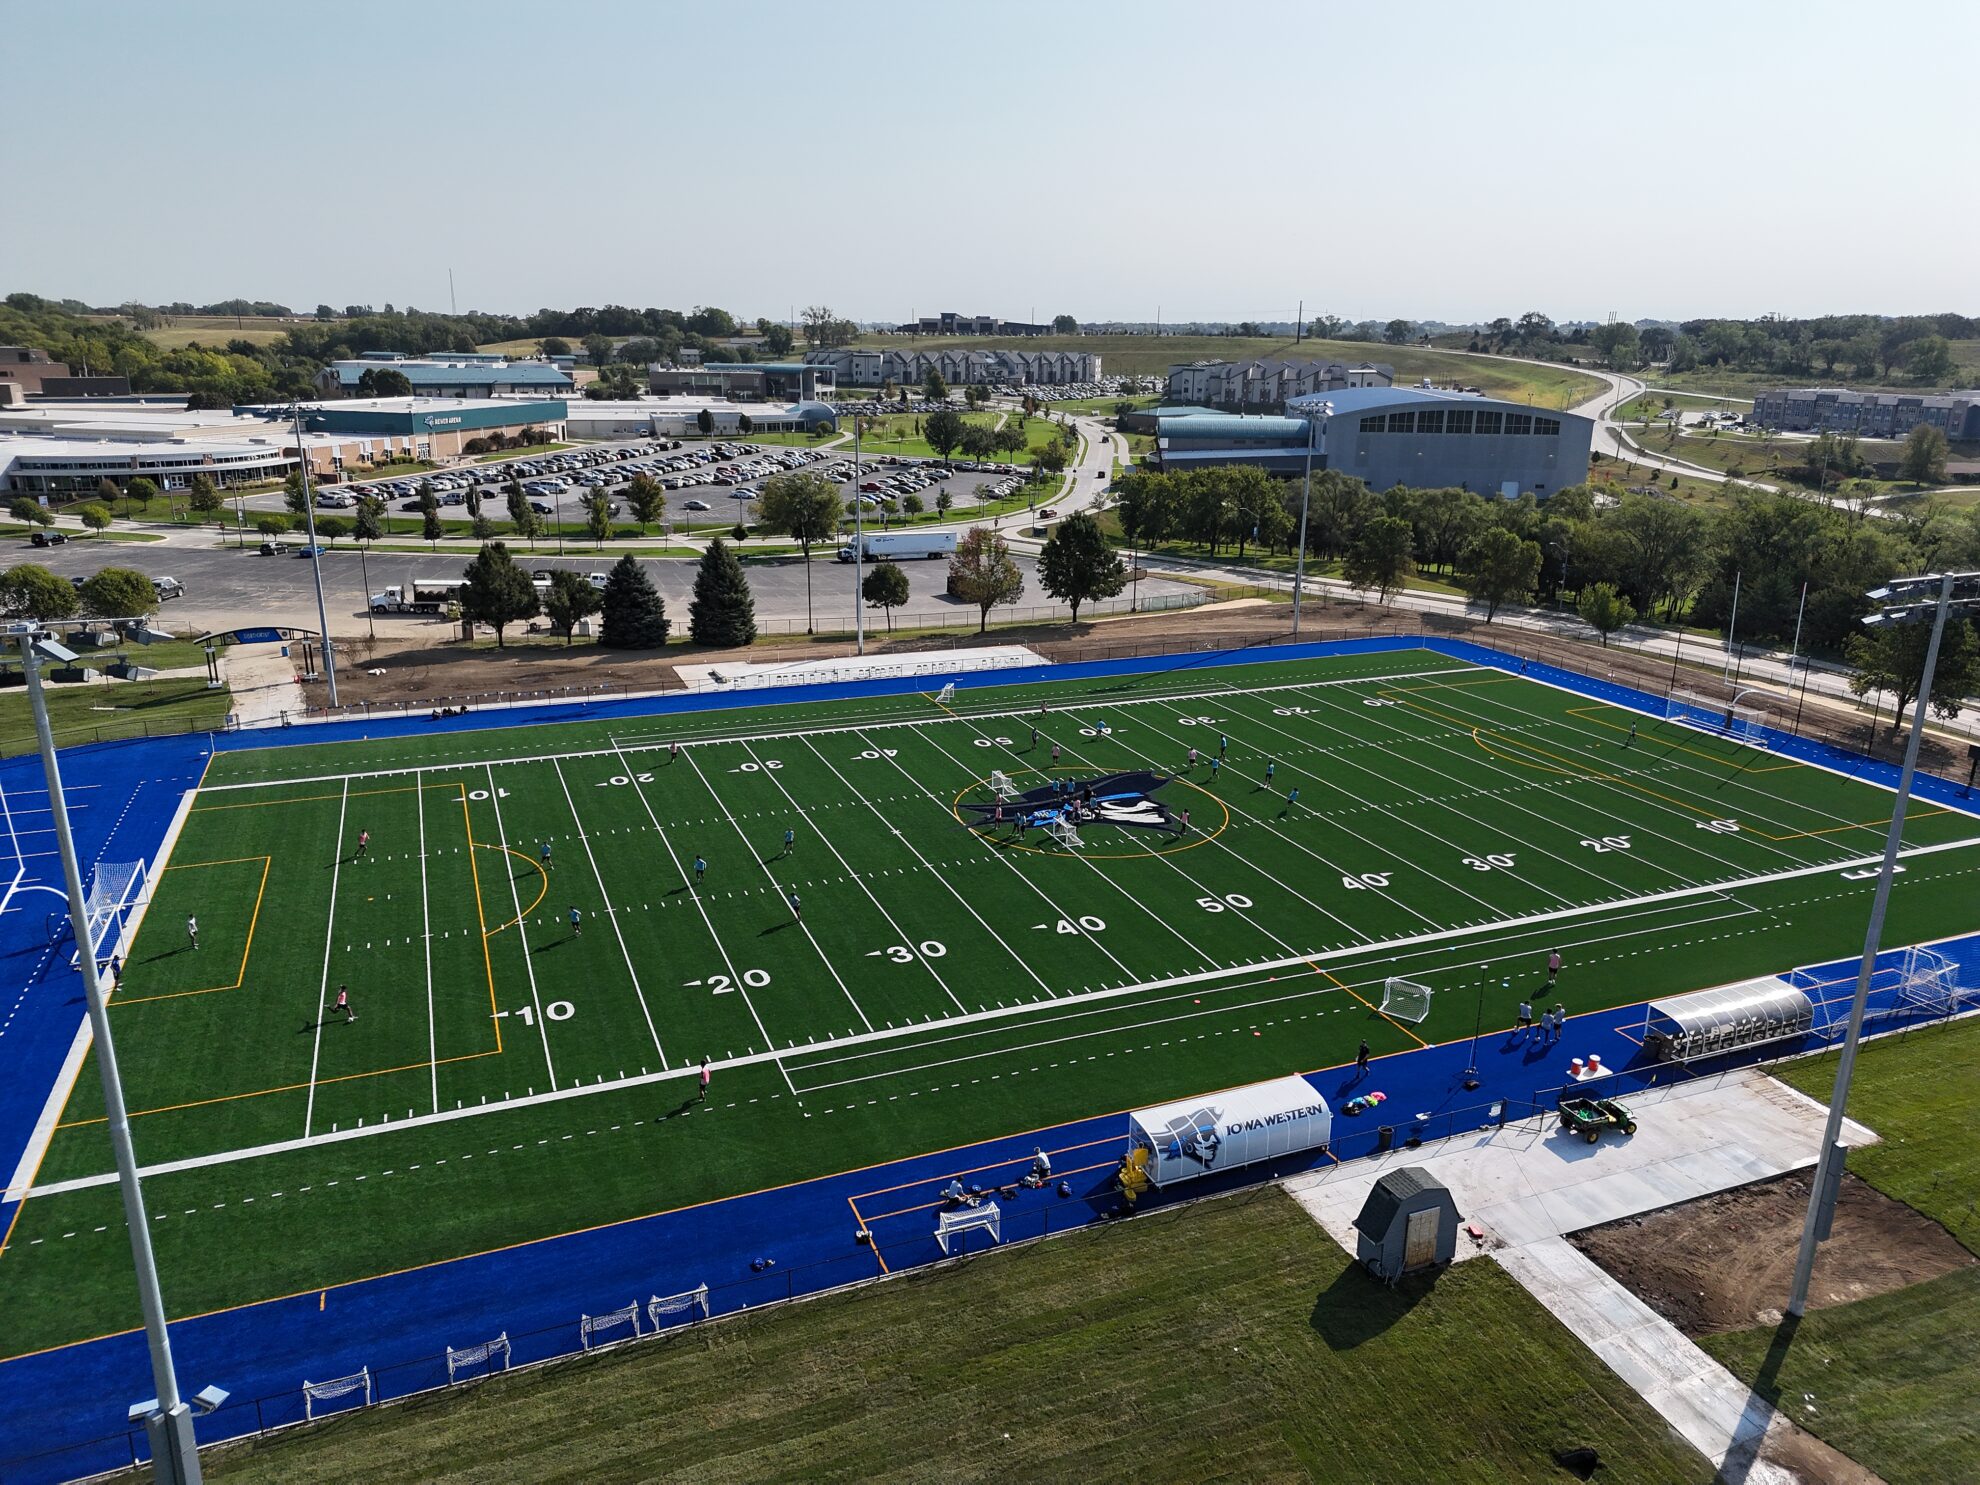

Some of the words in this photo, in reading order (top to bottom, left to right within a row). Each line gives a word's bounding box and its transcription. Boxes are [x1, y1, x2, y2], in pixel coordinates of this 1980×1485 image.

[1273, 706, 1310, 716] 20
[1363, 699, 1395, 707] 10
[1178, 716, 1216, 726] 30
[974, 737, 1013, 747] 50
[861, 748, 898, 760] 40
[740, 760, 784, 772] 30
[609, 772, 655, 786] 20
[469, 787, 511, 802] 10
[1695, 821, 1740, 834] 10
[1580, 836, 1631, 853] 20
[1462, 854, 1515, 872] 30
[1342, 873, 1390, 890] 40
[1195, 893, 1253, 913] 50
[1056, 915, 1106, 935] 40
[886, 940, 947, 964] 30
[707, 969, 771, 995] 20
[514, 1000, 576, 1026] 10
[1226, 1118, 1264, 1136] IOWA
[1264, 1104, 1323, 1127] WESTERN
